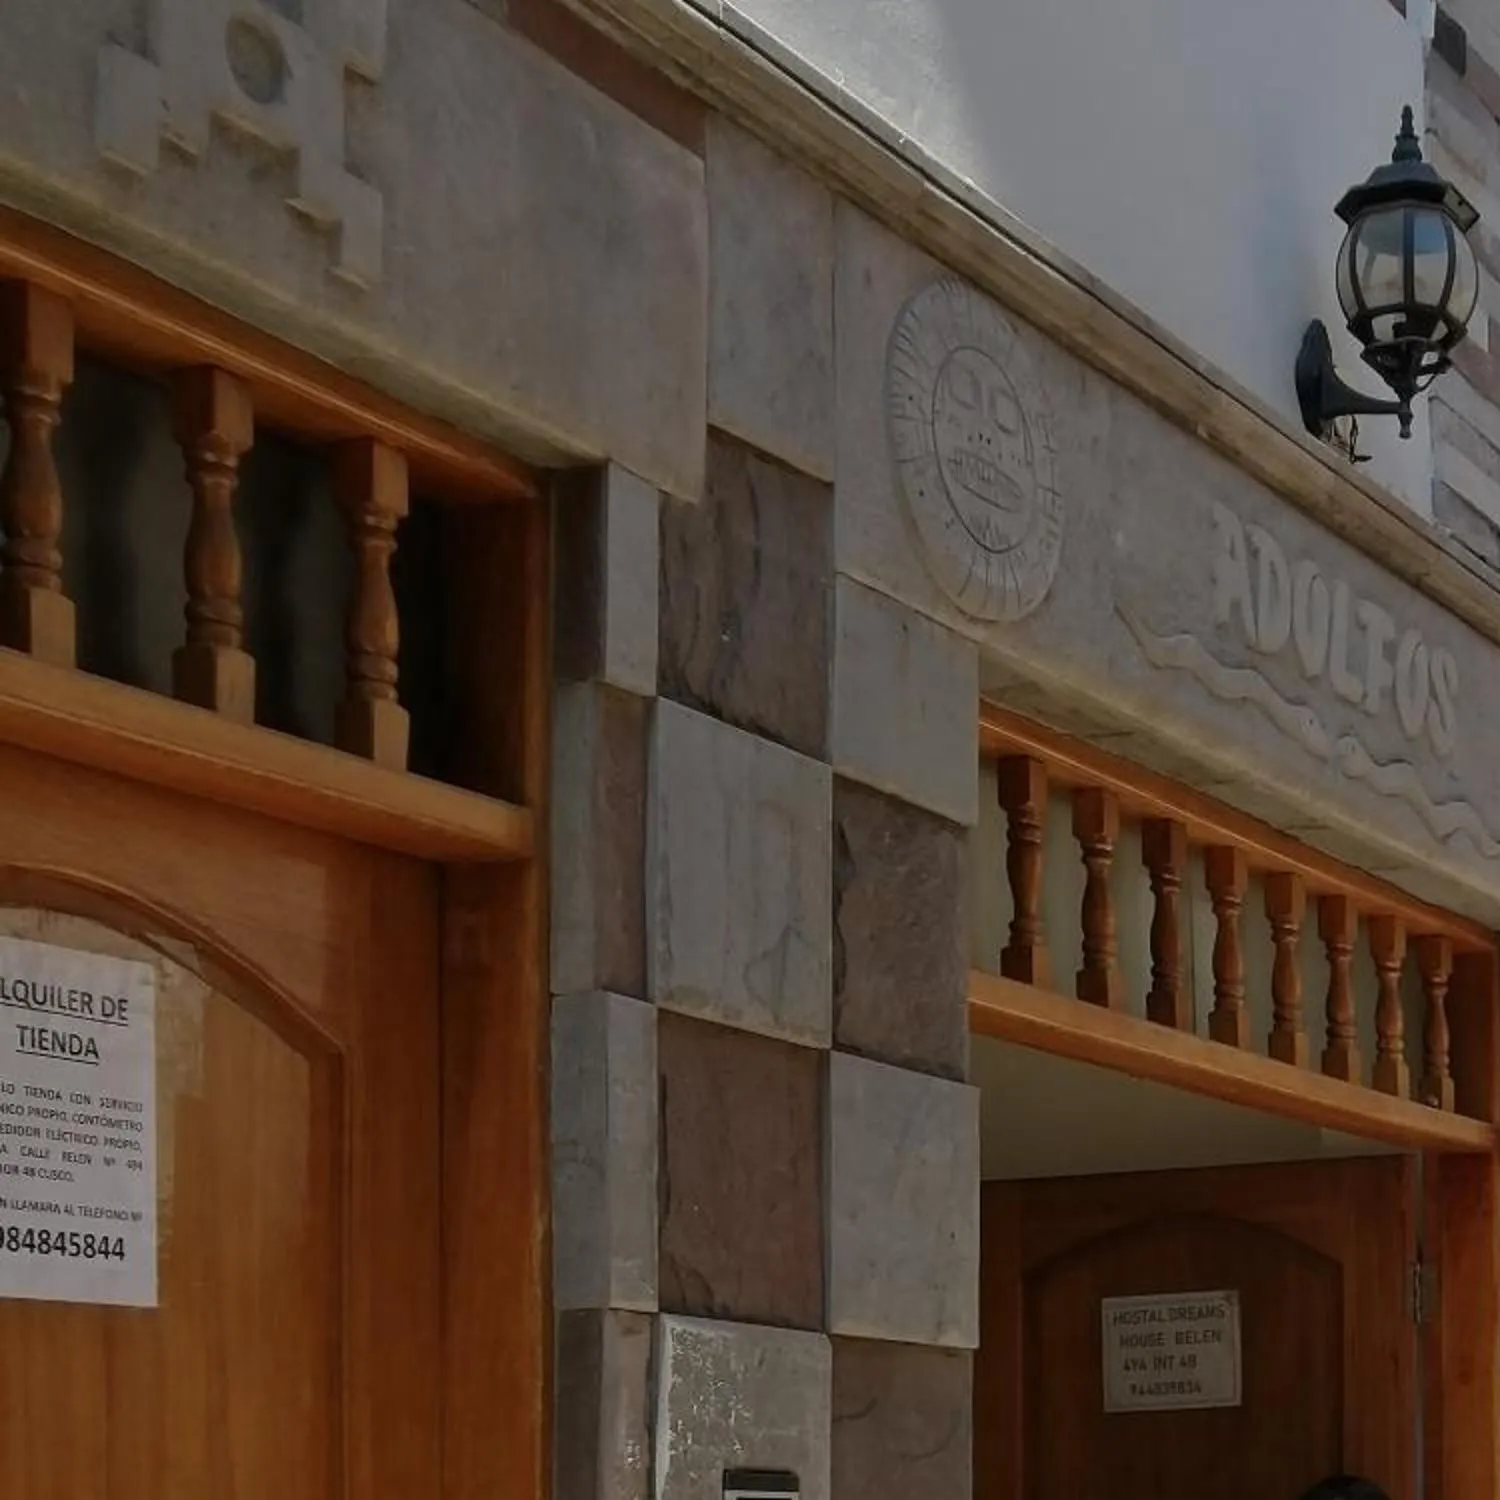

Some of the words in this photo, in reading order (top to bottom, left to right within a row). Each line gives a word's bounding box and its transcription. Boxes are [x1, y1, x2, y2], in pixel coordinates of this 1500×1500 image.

[0, 976, 93, 1015] LQUILER
[101, 995, 129, 1020] DE
[16, 1025, 99, 1059] TIENDA
[1113, 1308, 1168, 1326] HOSTAL
[1169, 1303, 1226, 1322] DREAMS
[1119, 1331, 1165, 1348] HOUSE
[1175, 1329, 1222, 1346] BELEN
